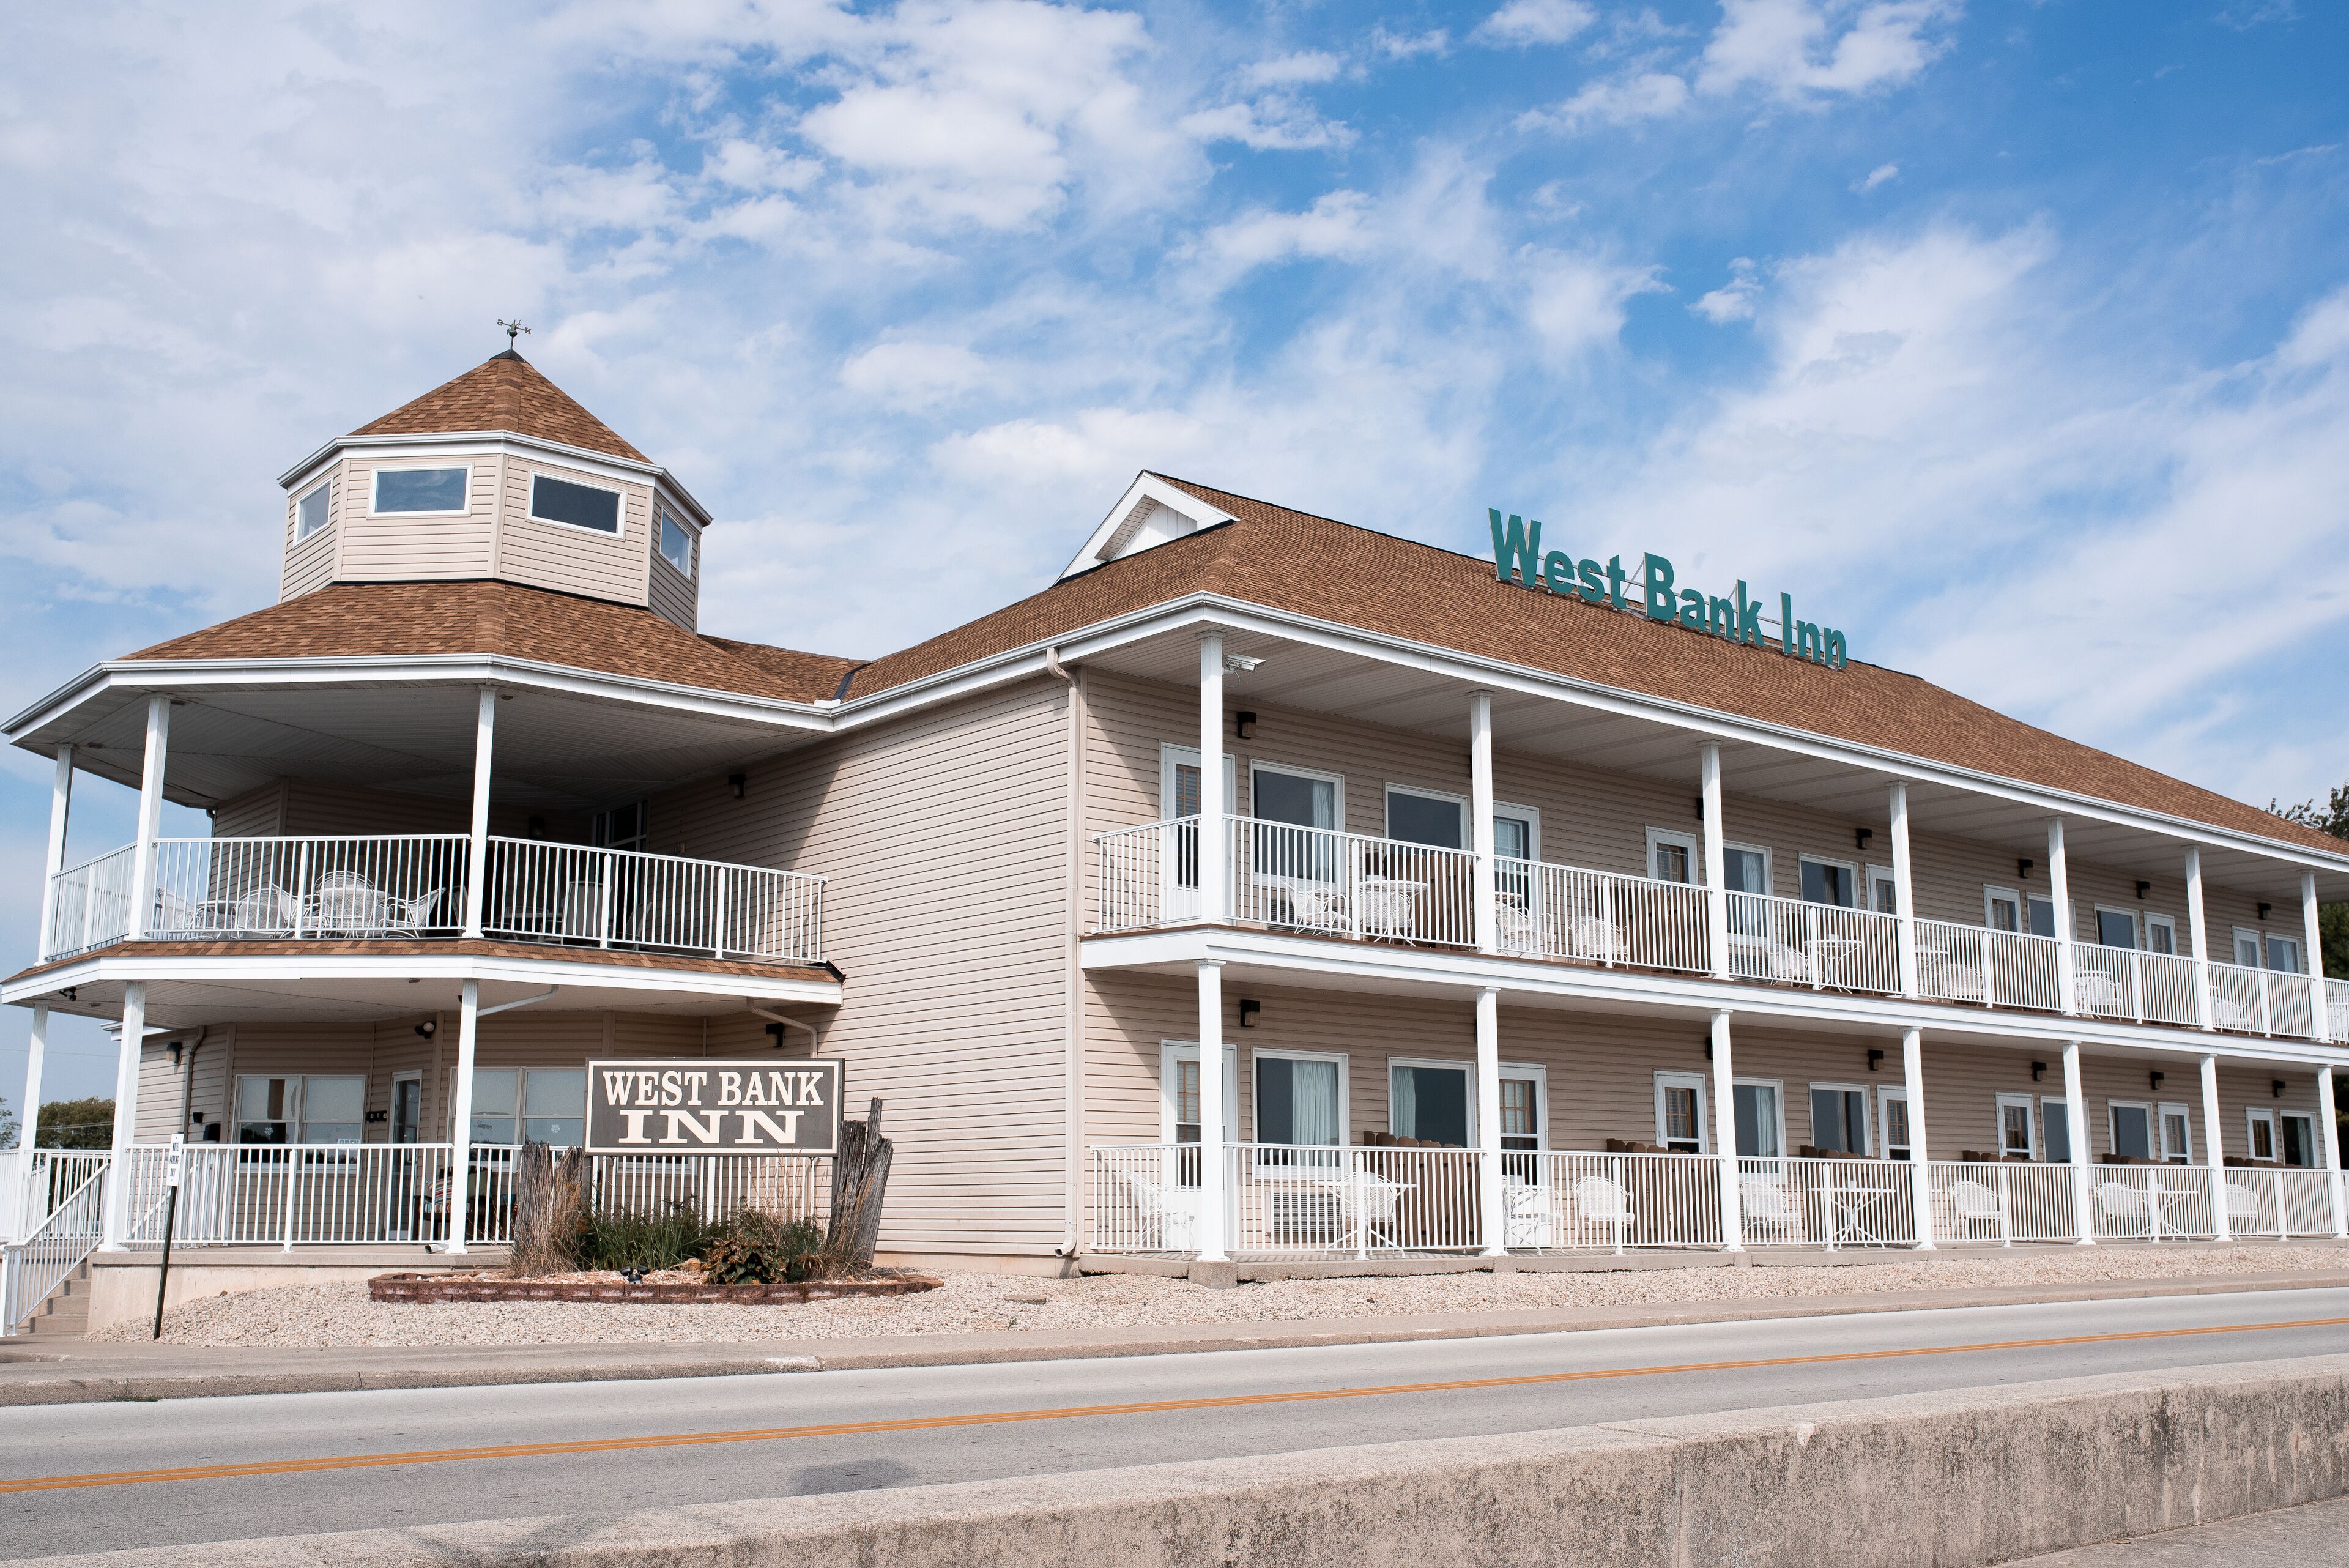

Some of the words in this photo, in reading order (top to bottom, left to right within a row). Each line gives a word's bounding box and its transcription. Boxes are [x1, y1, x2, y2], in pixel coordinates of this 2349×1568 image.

[1487, 507, 1627, 611] West
[1643, 552, 1765, 647] Bank
[1780, 592, 1847, 669] Inn
[603, 1070, 707, 1107] WEST
[718, 1071, 825, 1107] BANK
[618, 1110, 805, 1145] INN
